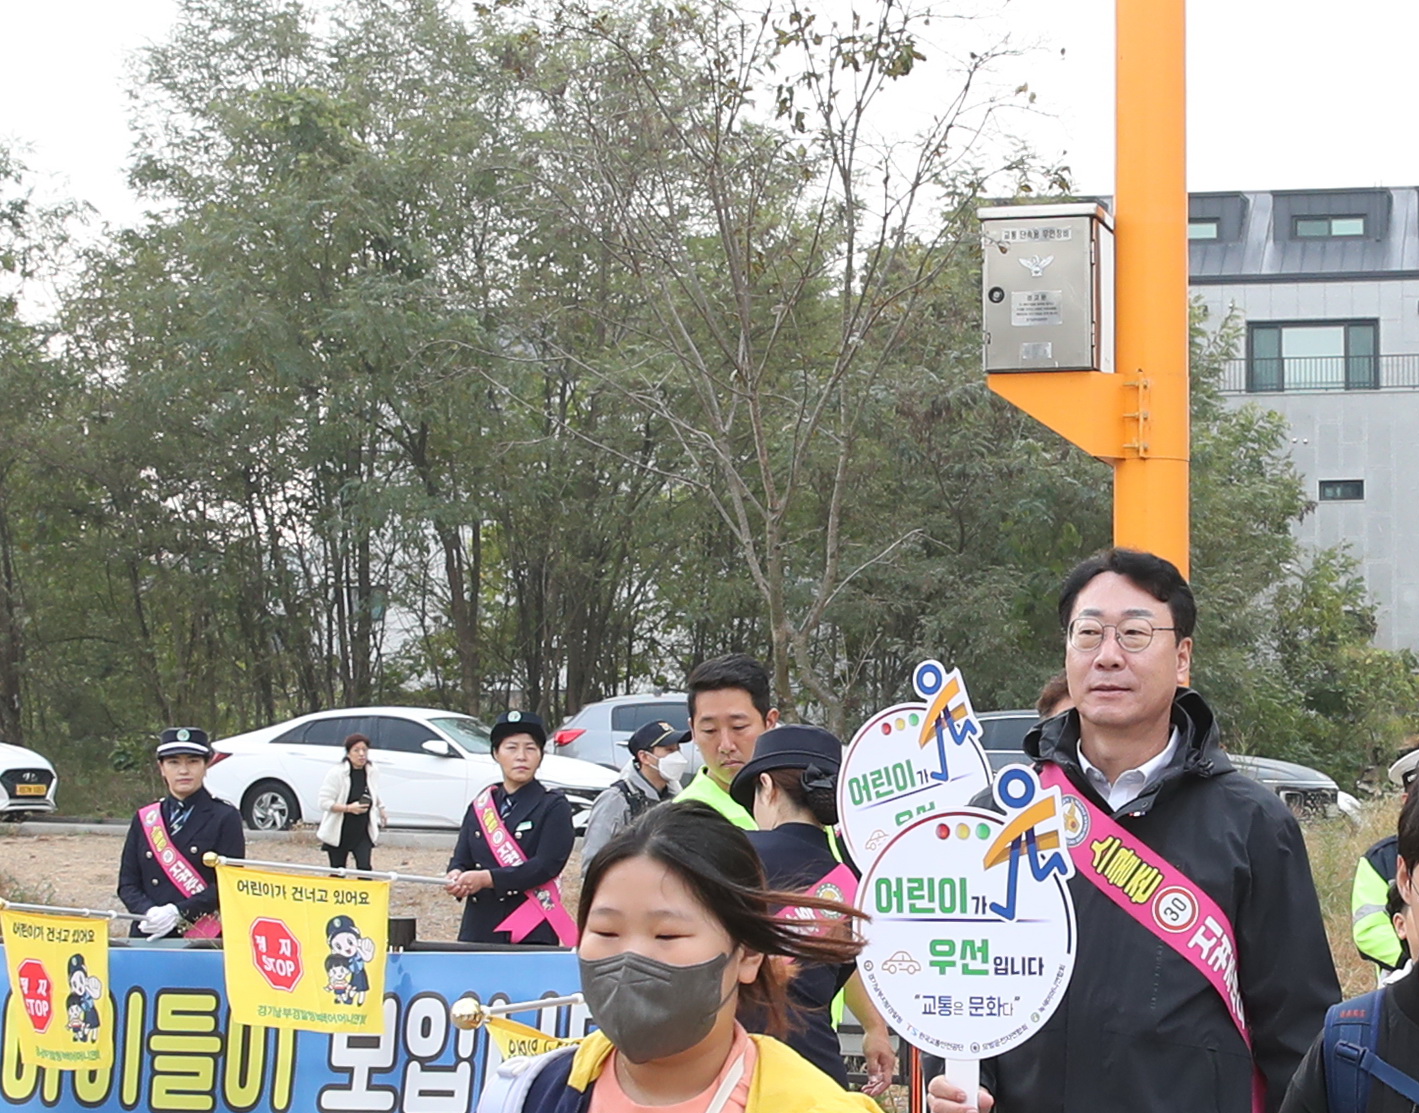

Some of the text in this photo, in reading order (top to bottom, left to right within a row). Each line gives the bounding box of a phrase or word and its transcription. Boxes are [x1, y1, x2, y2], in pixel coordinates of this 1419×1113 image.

[848, 759, 928, 806] 어린이가
[237, 880, 371, 906] 어린이가 건너고 있어요
[875, 876, 987, 916] 어린이가
[1163, 897, 1187, 922] 30
[262, 955, 296, 977] STOP
[929, 938, 1045, 976] 우선입니다
